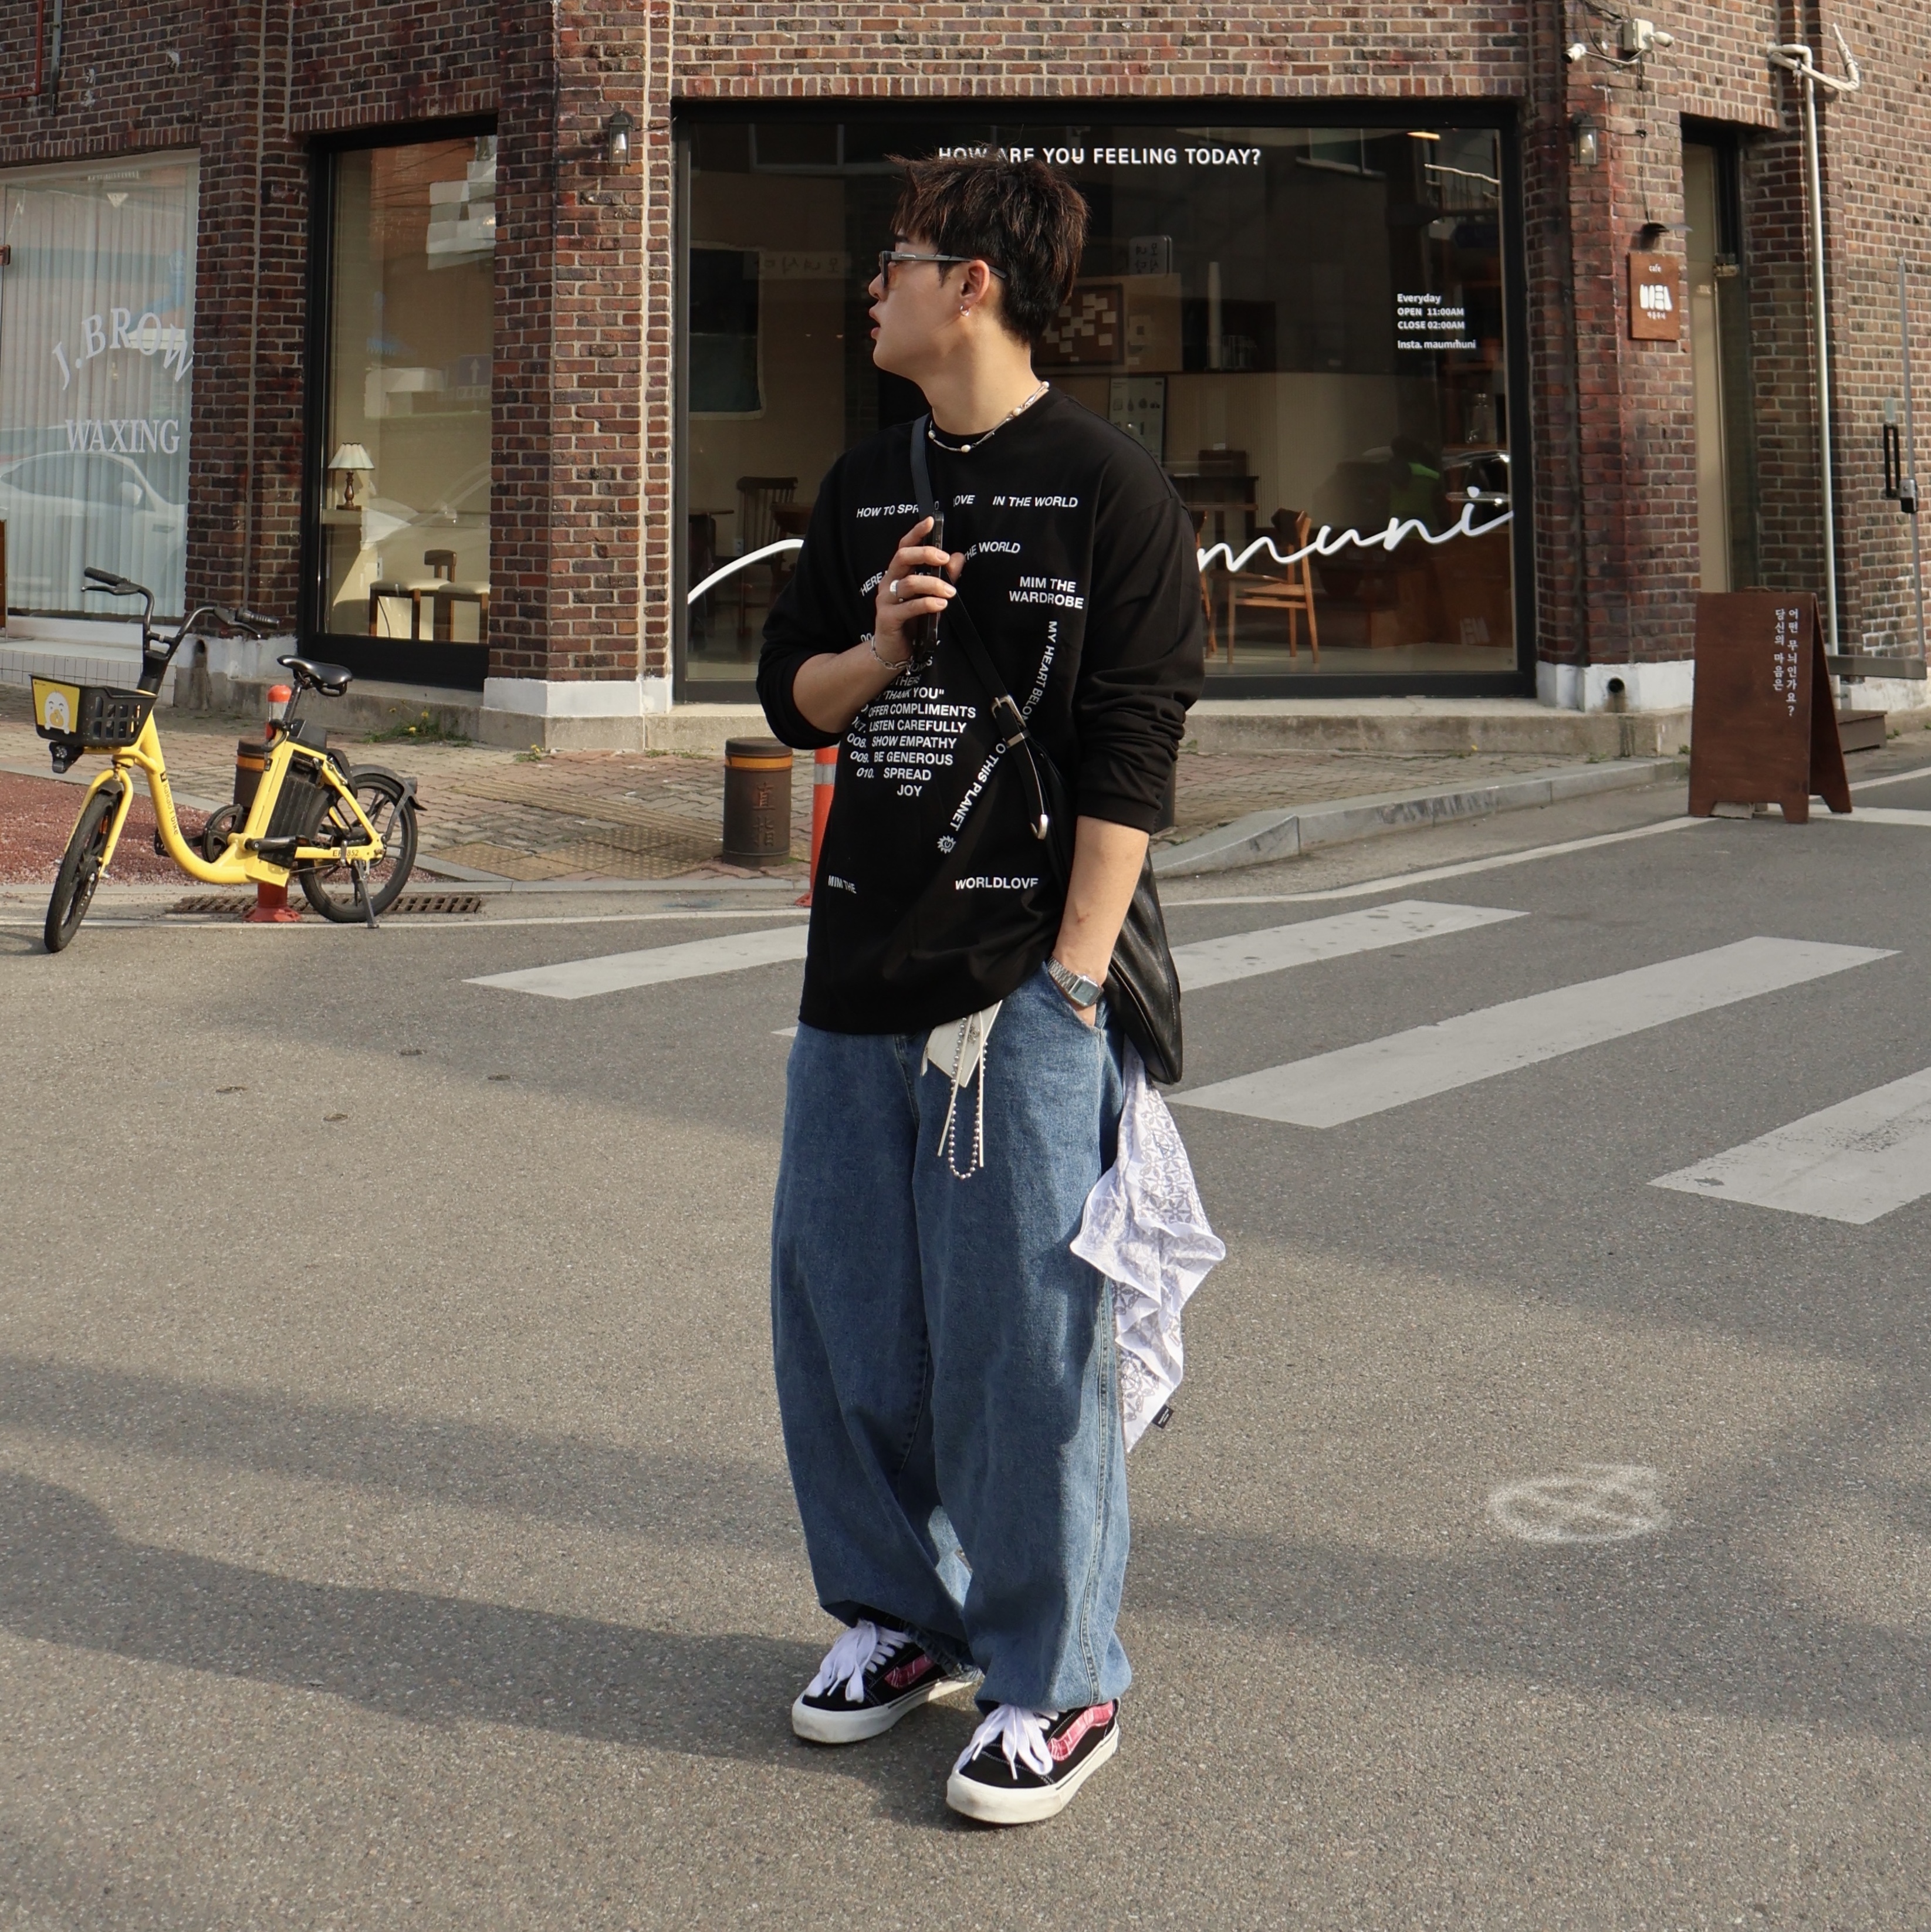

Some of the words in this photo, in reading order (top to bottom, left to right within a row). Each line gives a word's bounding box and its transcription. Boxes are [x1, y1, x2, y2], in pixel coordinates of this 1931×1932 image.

[1042, 147, 1084, 164] YOU
[1094, 148, 1177, 164] FEELING
[1184, 148, 1261, 165] TODAY?
[1649, 263, 1662, 272] cafe
[1397, 293, 1441, 304] Everyday
[1397, 307, 1422, 316] OPEN
[1427, 307, 1465, 316] 11:00AM
[1397, 320, 1426, 330] CLOSE
[1427, 321, 1465, 330] 02:00AM
[1397, 340, 1423, 349] Insta.
[65, 418, 180, 454] WAXING
[856, 507, 882, 518] HOW
[884, 505, 895, 516] TO
[992, 496, 1006, 506] IN
[1009, 496, 1032, 507] THE
[1034, 496, 1078, 507] WORLD
[979, 541, 1021, 554] WORLD
[1019, 576, 1047, 588] MIM
[1050, 578, 1076, 593] THE
[1009, 589, 1084, 610] WARDROBE
[1774, 608, 1785, 645] 당신의
[1788, 608, 1799, 634] 어떤
[1047, 621, 1057, 643] MY
[1036, 645, 1055, 688] HEART
[1773, 652, 1784, 692] 마음은
[1785, 639, 1798, 717] 무늬인가요?
[914, 687, 945, 699] YOU"
[868, 704, 890, 718] OFFER
[890, 703, 976, 719] COMPLIMENTS
[869, 719, 895, 732] LISTEN
[897, 719, 967, 733] CAREFULLY
[871, 735, 899, 747] SHOW
[899, 735, 957, 749] EMPATHY
[874, 751, 885, 763] BE
[887, 751, 953, 766] GENEROUS
[883, 767, 932, 781] SPREAD
[978, 754, 999, 783] THIS
[897, 784, 922, 797] JOY
[950, 780, 985, 831] PLANET
[828, 875, 843, 888] MIM
[843, 879, 857, 894] THE
